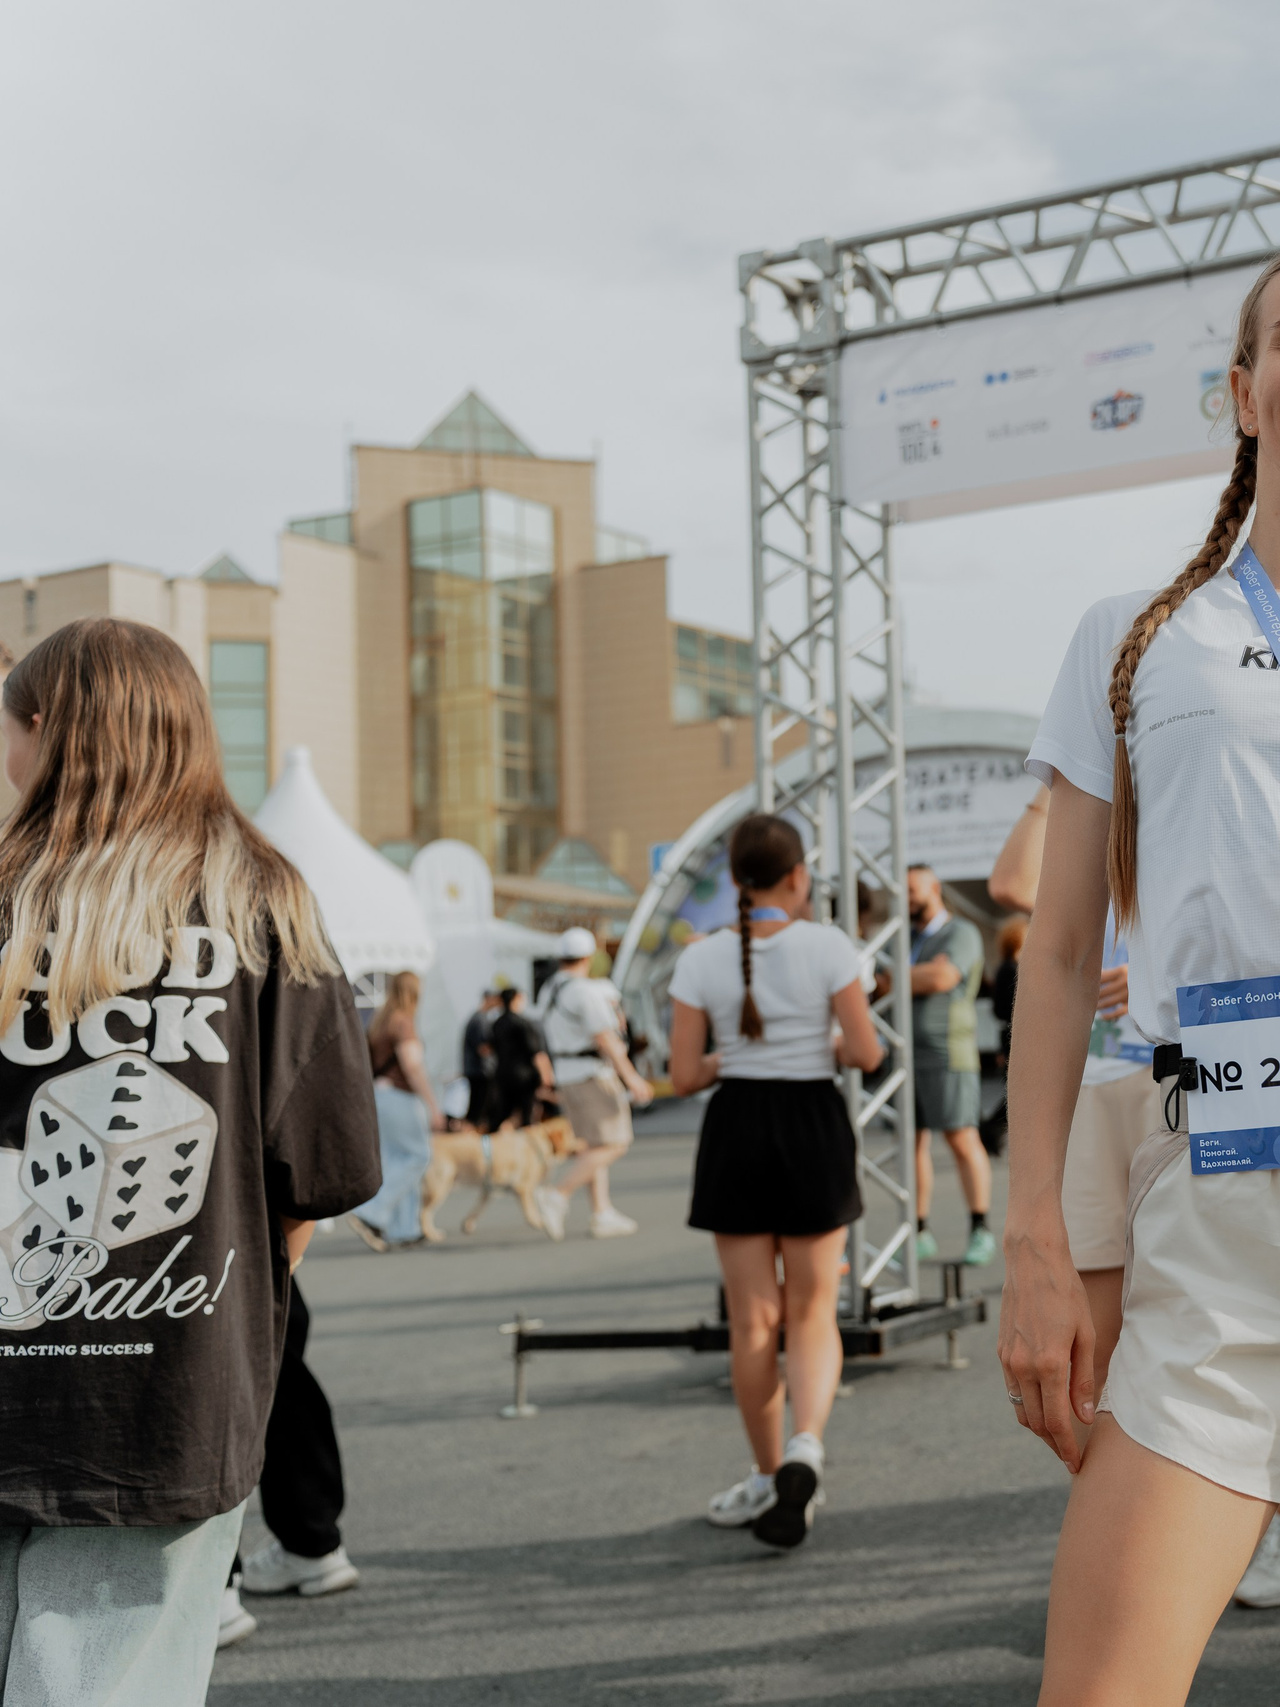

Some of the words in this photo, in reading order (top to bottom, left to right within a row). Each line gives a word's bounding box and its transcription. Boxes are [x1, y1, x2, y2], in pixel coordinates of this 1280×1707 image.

[1240, 560, 1261, 588] Забег
[1148, 719, 1166, 733] NEW
[1210, 996, 1243, 1007] Забег
[1199, 1139, 1222, 1147] Беги.
[1200, 1148, 1239, 1158] Помогай.
[1201, 1157, 1254, 1169] Вдохновляй.
[0, 1235, 236, 1321] Babe!
[80, 1343, 155, 1356] SUCCESS
